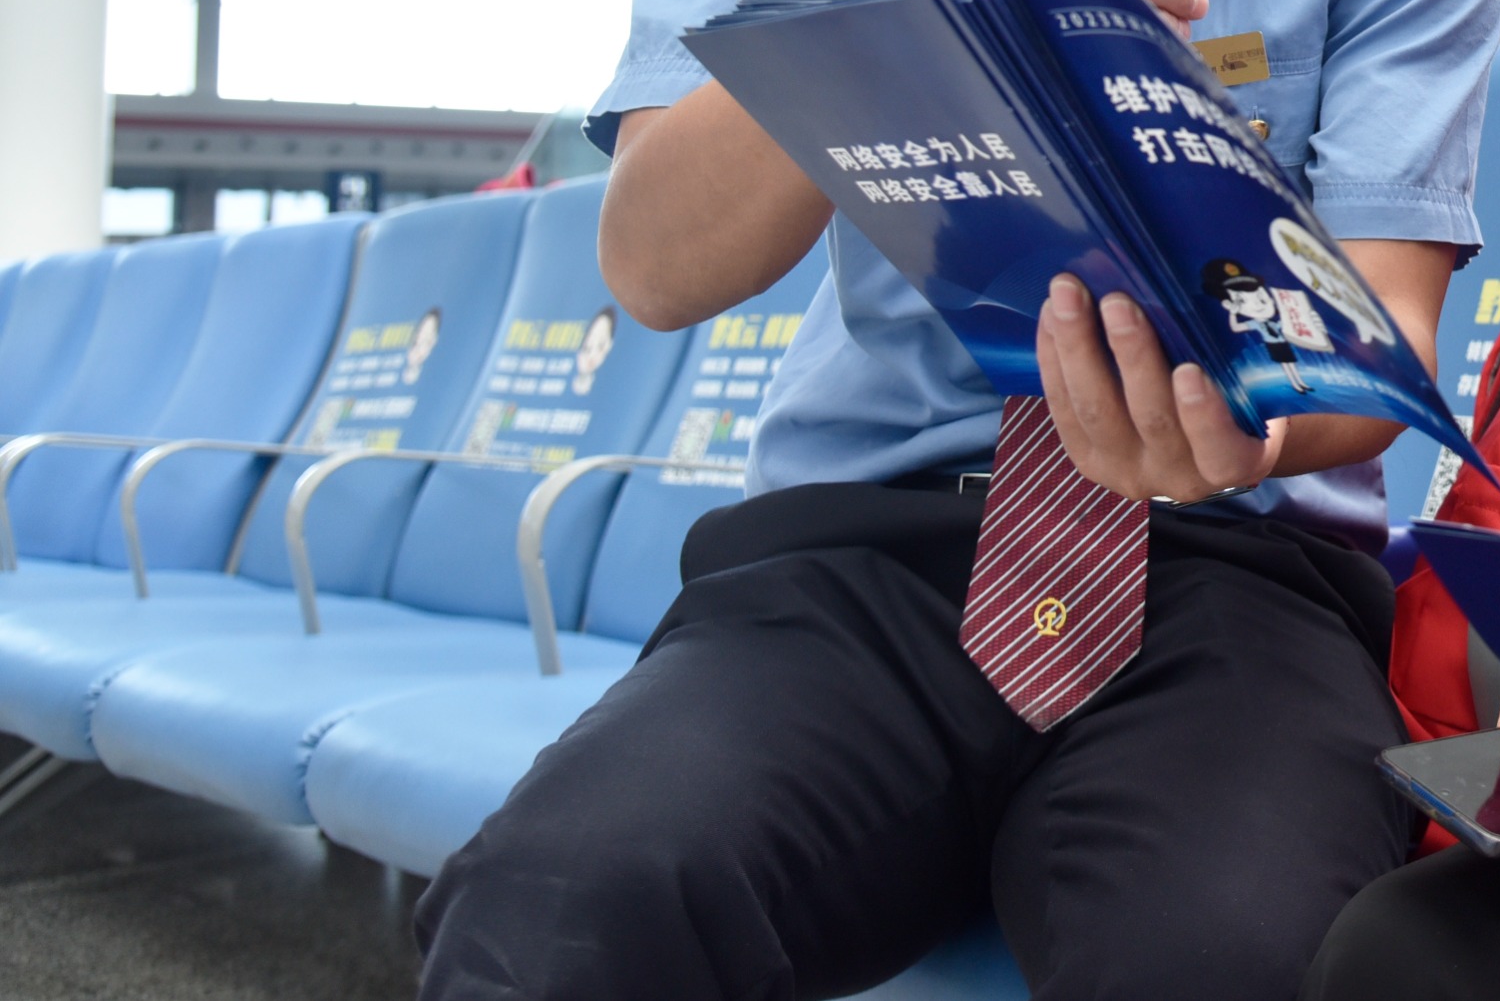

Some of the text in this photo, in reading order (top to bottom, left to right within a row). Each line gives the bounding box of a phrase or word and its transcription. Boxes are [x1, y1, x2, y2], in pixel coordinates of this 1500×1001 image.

[827, 133, 1016, 171] 网络安全为人民
[855, 169, 1043, 204] 网络安全靠人民
